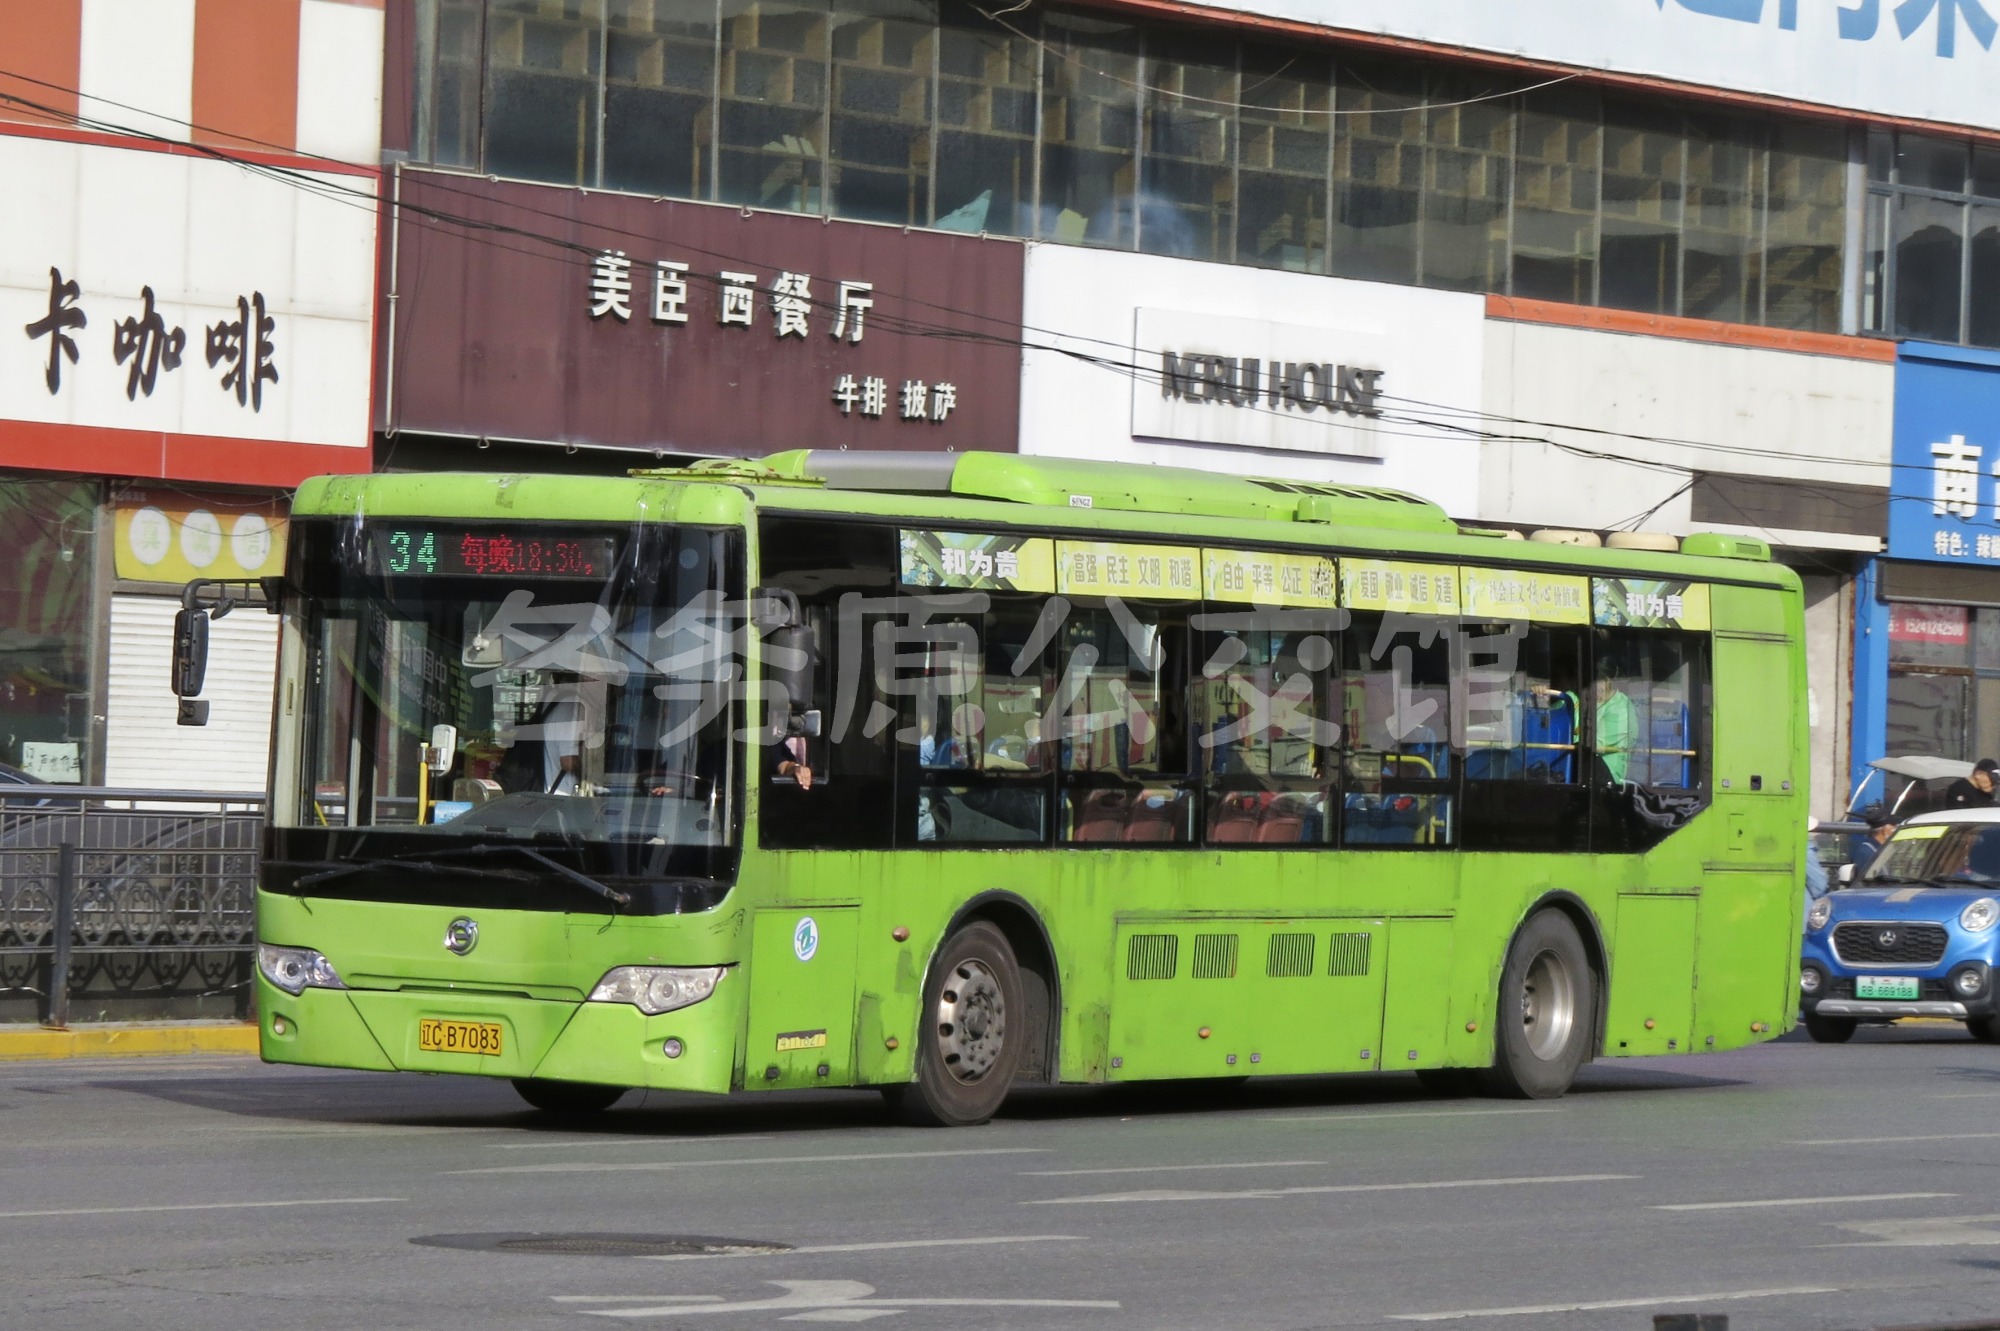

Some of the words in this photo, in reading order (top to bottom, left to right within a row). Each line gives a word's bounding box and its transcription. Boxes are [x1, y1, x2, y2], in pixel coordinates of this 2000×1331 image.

[591, 250, 874, 343] 美臣西餐厅
[834, 373, 888, 417] 牛排
[901, 380, 957, 422] 披萨
[1268, 361, 1384, 419] HOUSE
[389, 531, 437, 573] 34
[941, 547, 1019, 579] 和为贵
[1073, 553, 1098, 584] 富强
[1106, 555, 1131, 586] 民主
[1137, 556, 1162, 587] 文明
[1168, 558, 1193, 588] 和谐
[1223, 561, 1245, 591] 自由
[1251, 563, 1273, 594] 平等
[1281, 565, 1303, 596] 公正
[1360, 571, 1379, 600] 爱国
[1624, 593, 1684, 620] 和为贵
